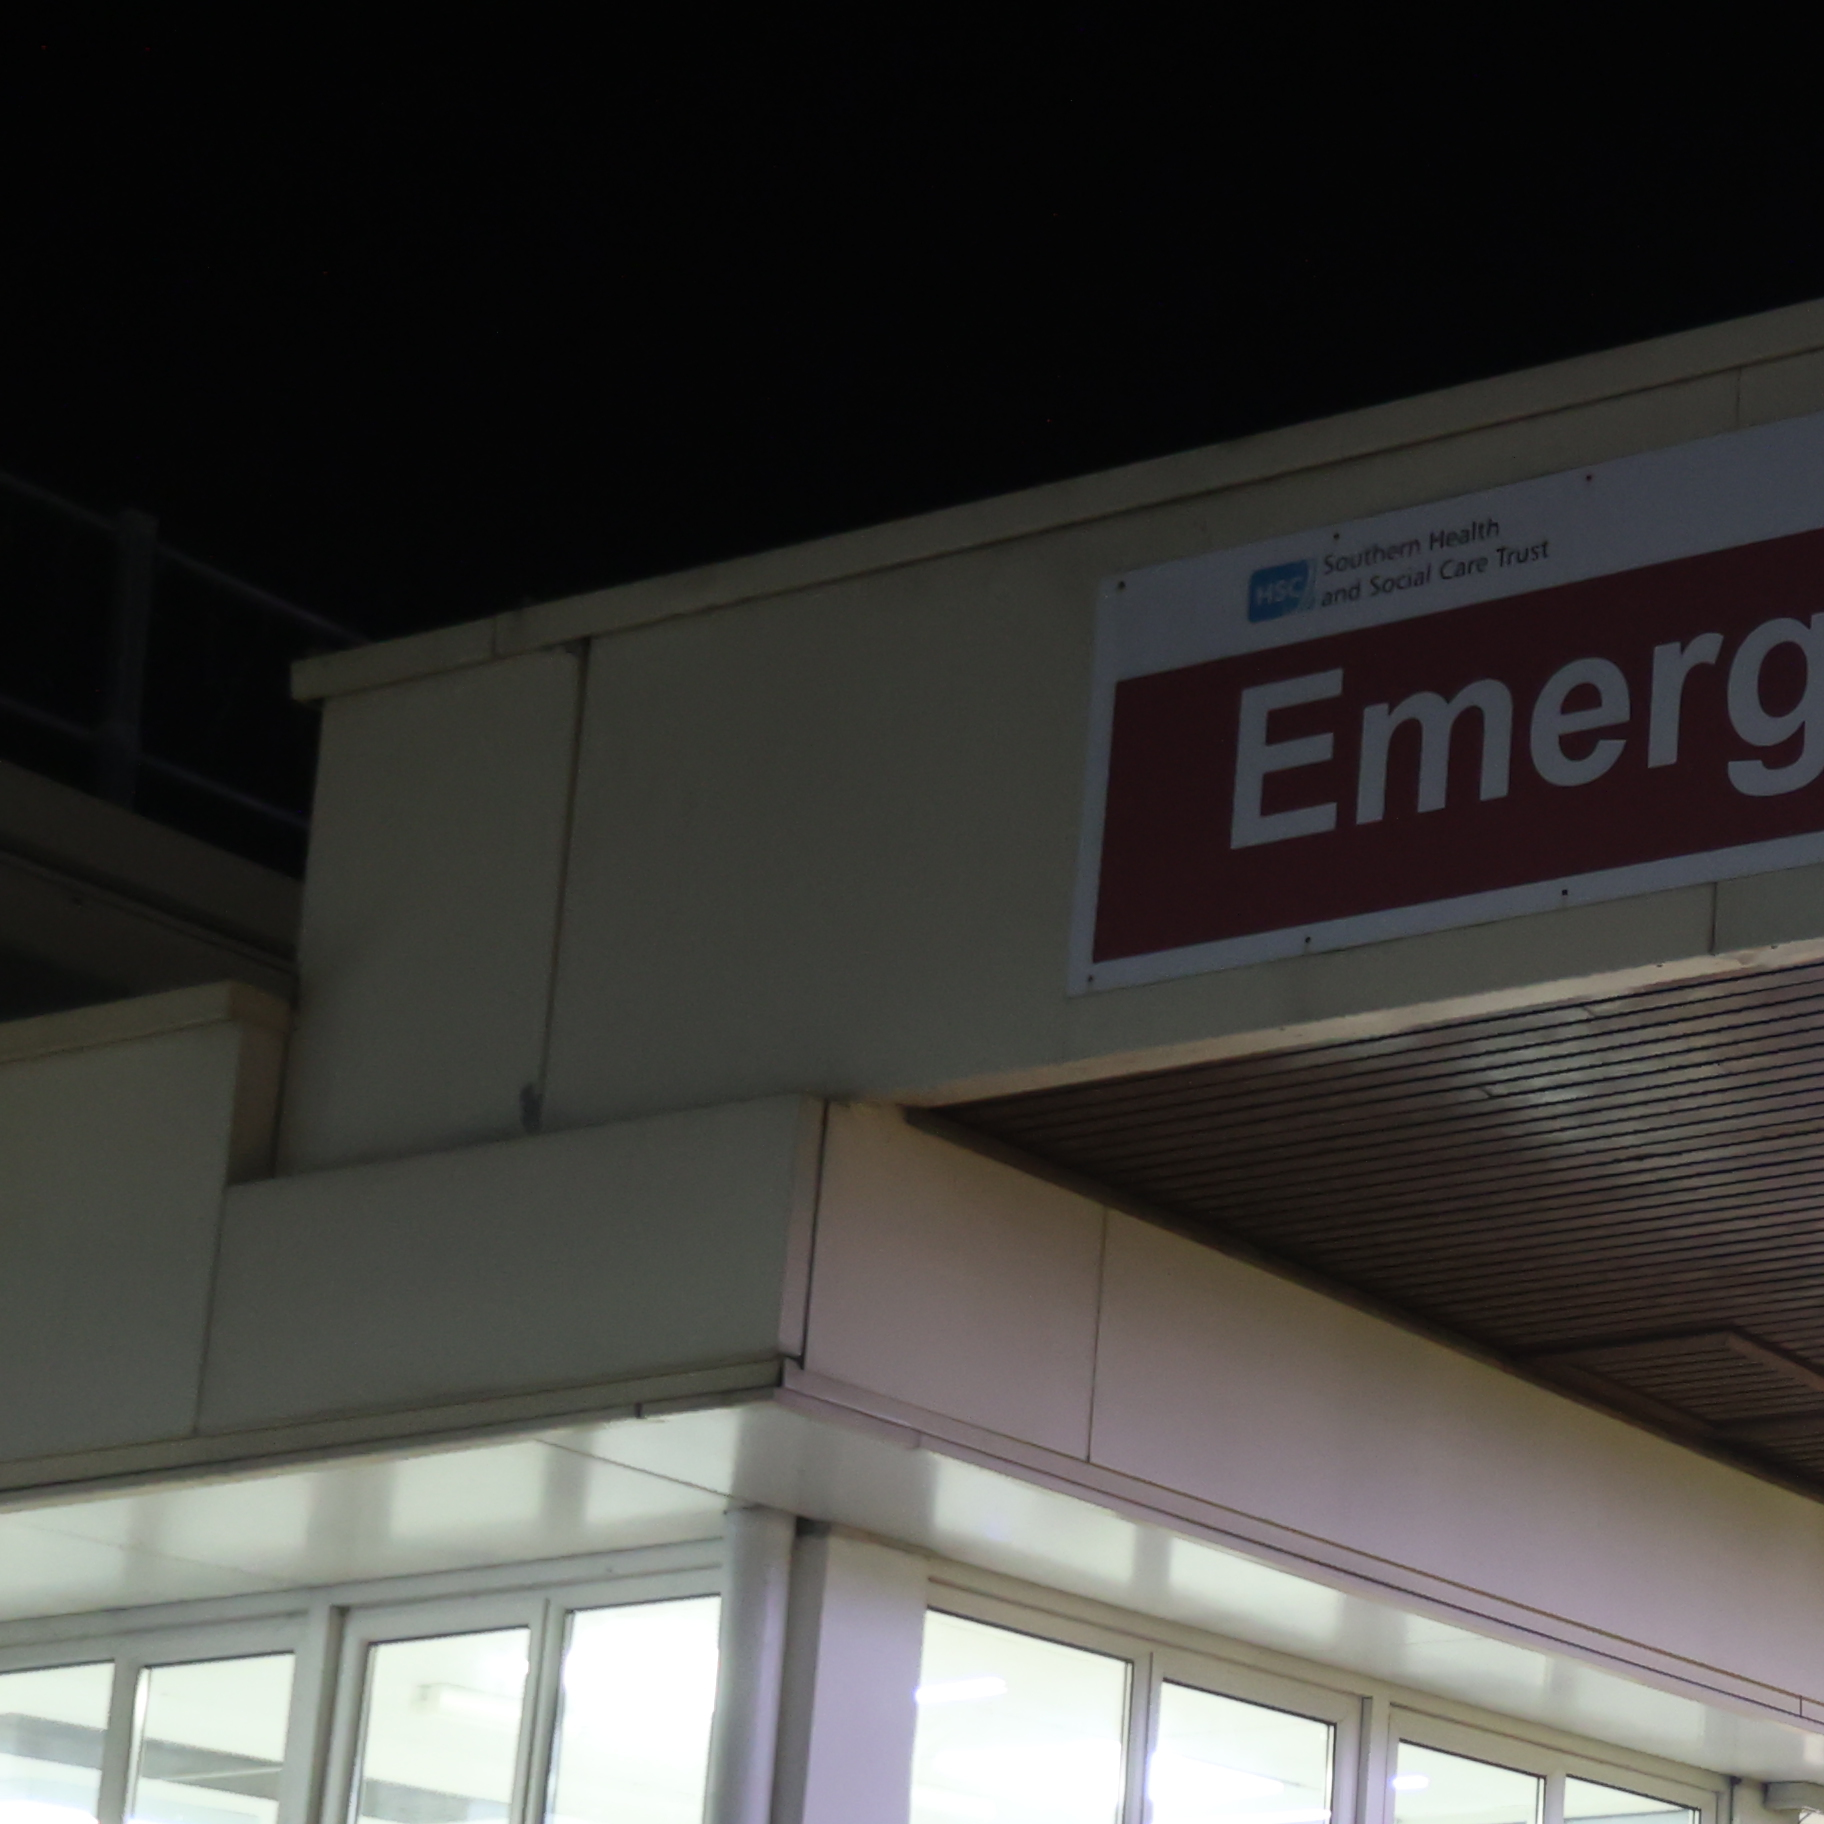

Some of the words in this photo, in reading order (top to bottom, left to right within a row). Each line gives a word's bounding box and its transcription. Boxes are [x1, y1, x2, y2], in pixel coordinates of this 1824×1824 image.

[1321, 582, 1361, 607] and
[1370, 563, 1432, 597] Social
[1440, 555, 1489, 581] Care
[1496, 540, 1550, 568] Trust
[1324, 538, 1421, 576] Southern
[1429, 518, 1500, 552] Health
[1256, 576, 1304, 607] HSC
